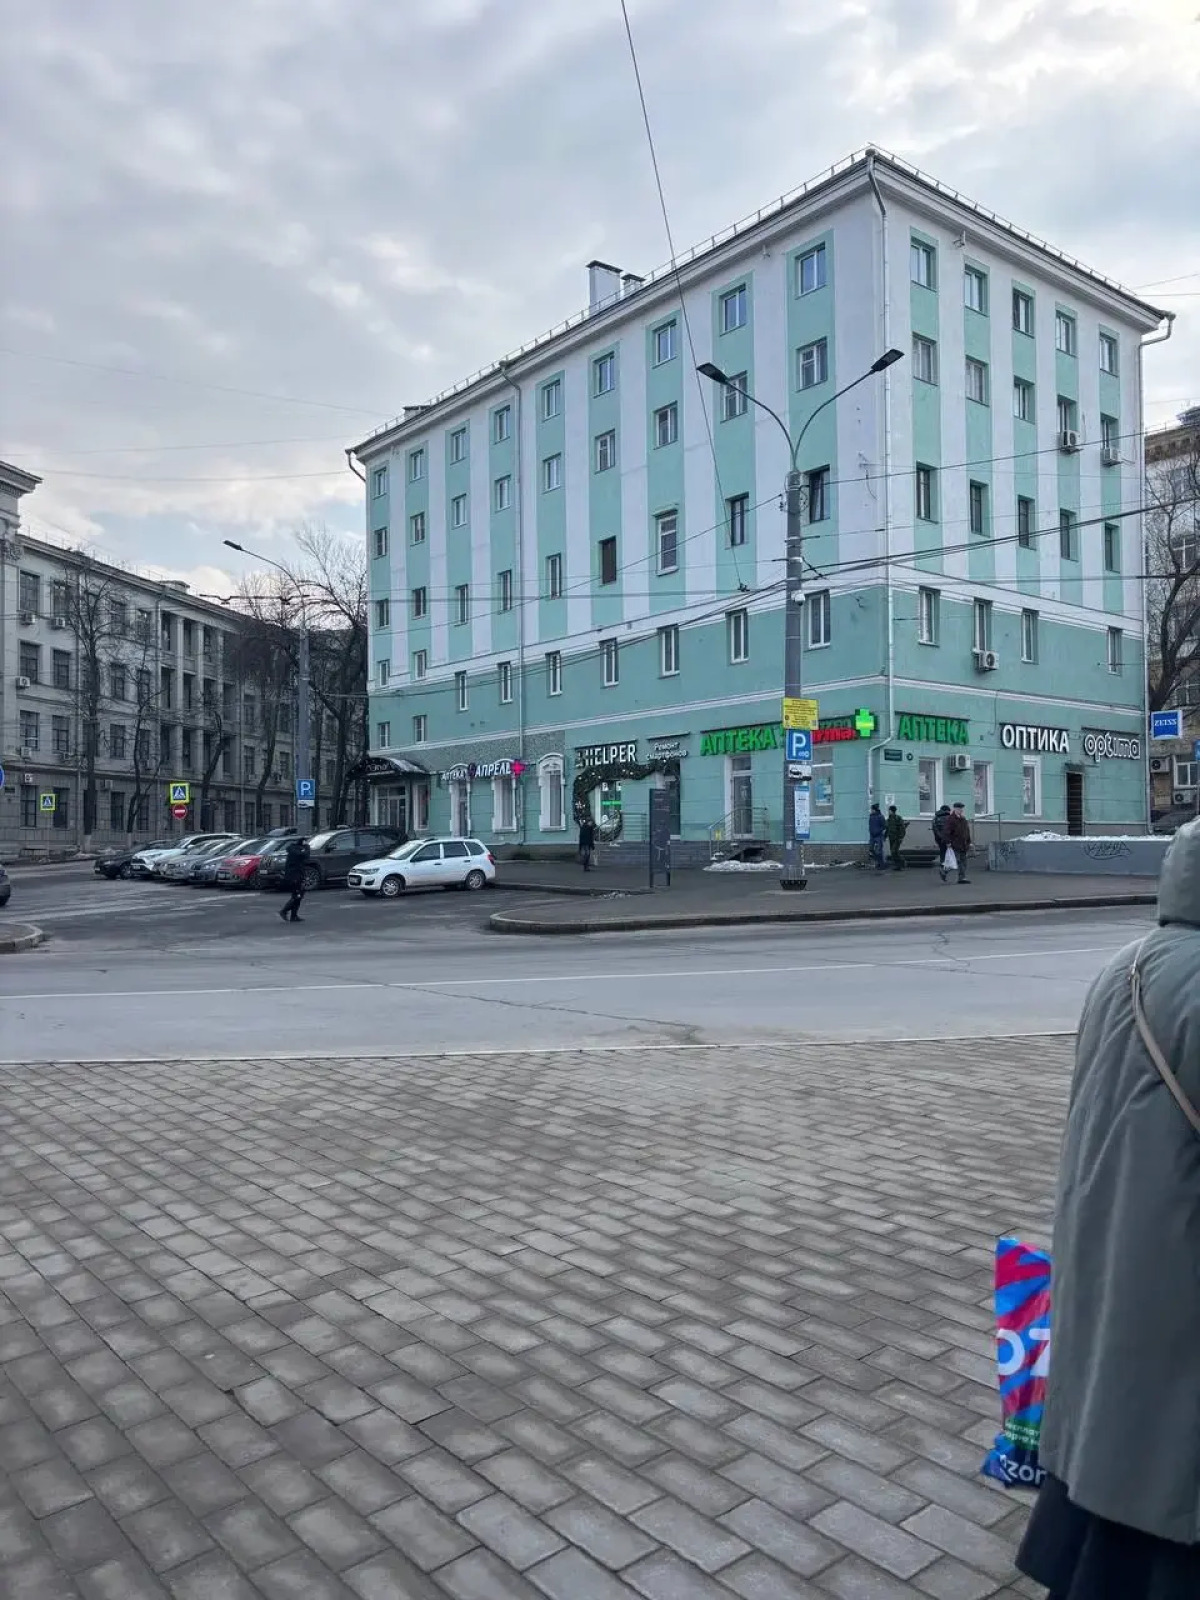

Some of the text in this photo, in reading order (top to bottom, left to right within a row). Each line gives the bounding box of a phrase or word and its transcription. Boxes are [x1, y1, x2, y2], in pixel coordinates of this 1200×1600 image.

[899, 714, 968, 745] АПТЕКА
[1154, 718, 1177, 727] ZEISS
[700, 728, 777, 756] АПТЕКА
[1002, 724, 1070, 753] ОПТИКА
[1084, 732, 1141, 763] optima
[475, 762, 511, 777] АПРЕЛЬ
